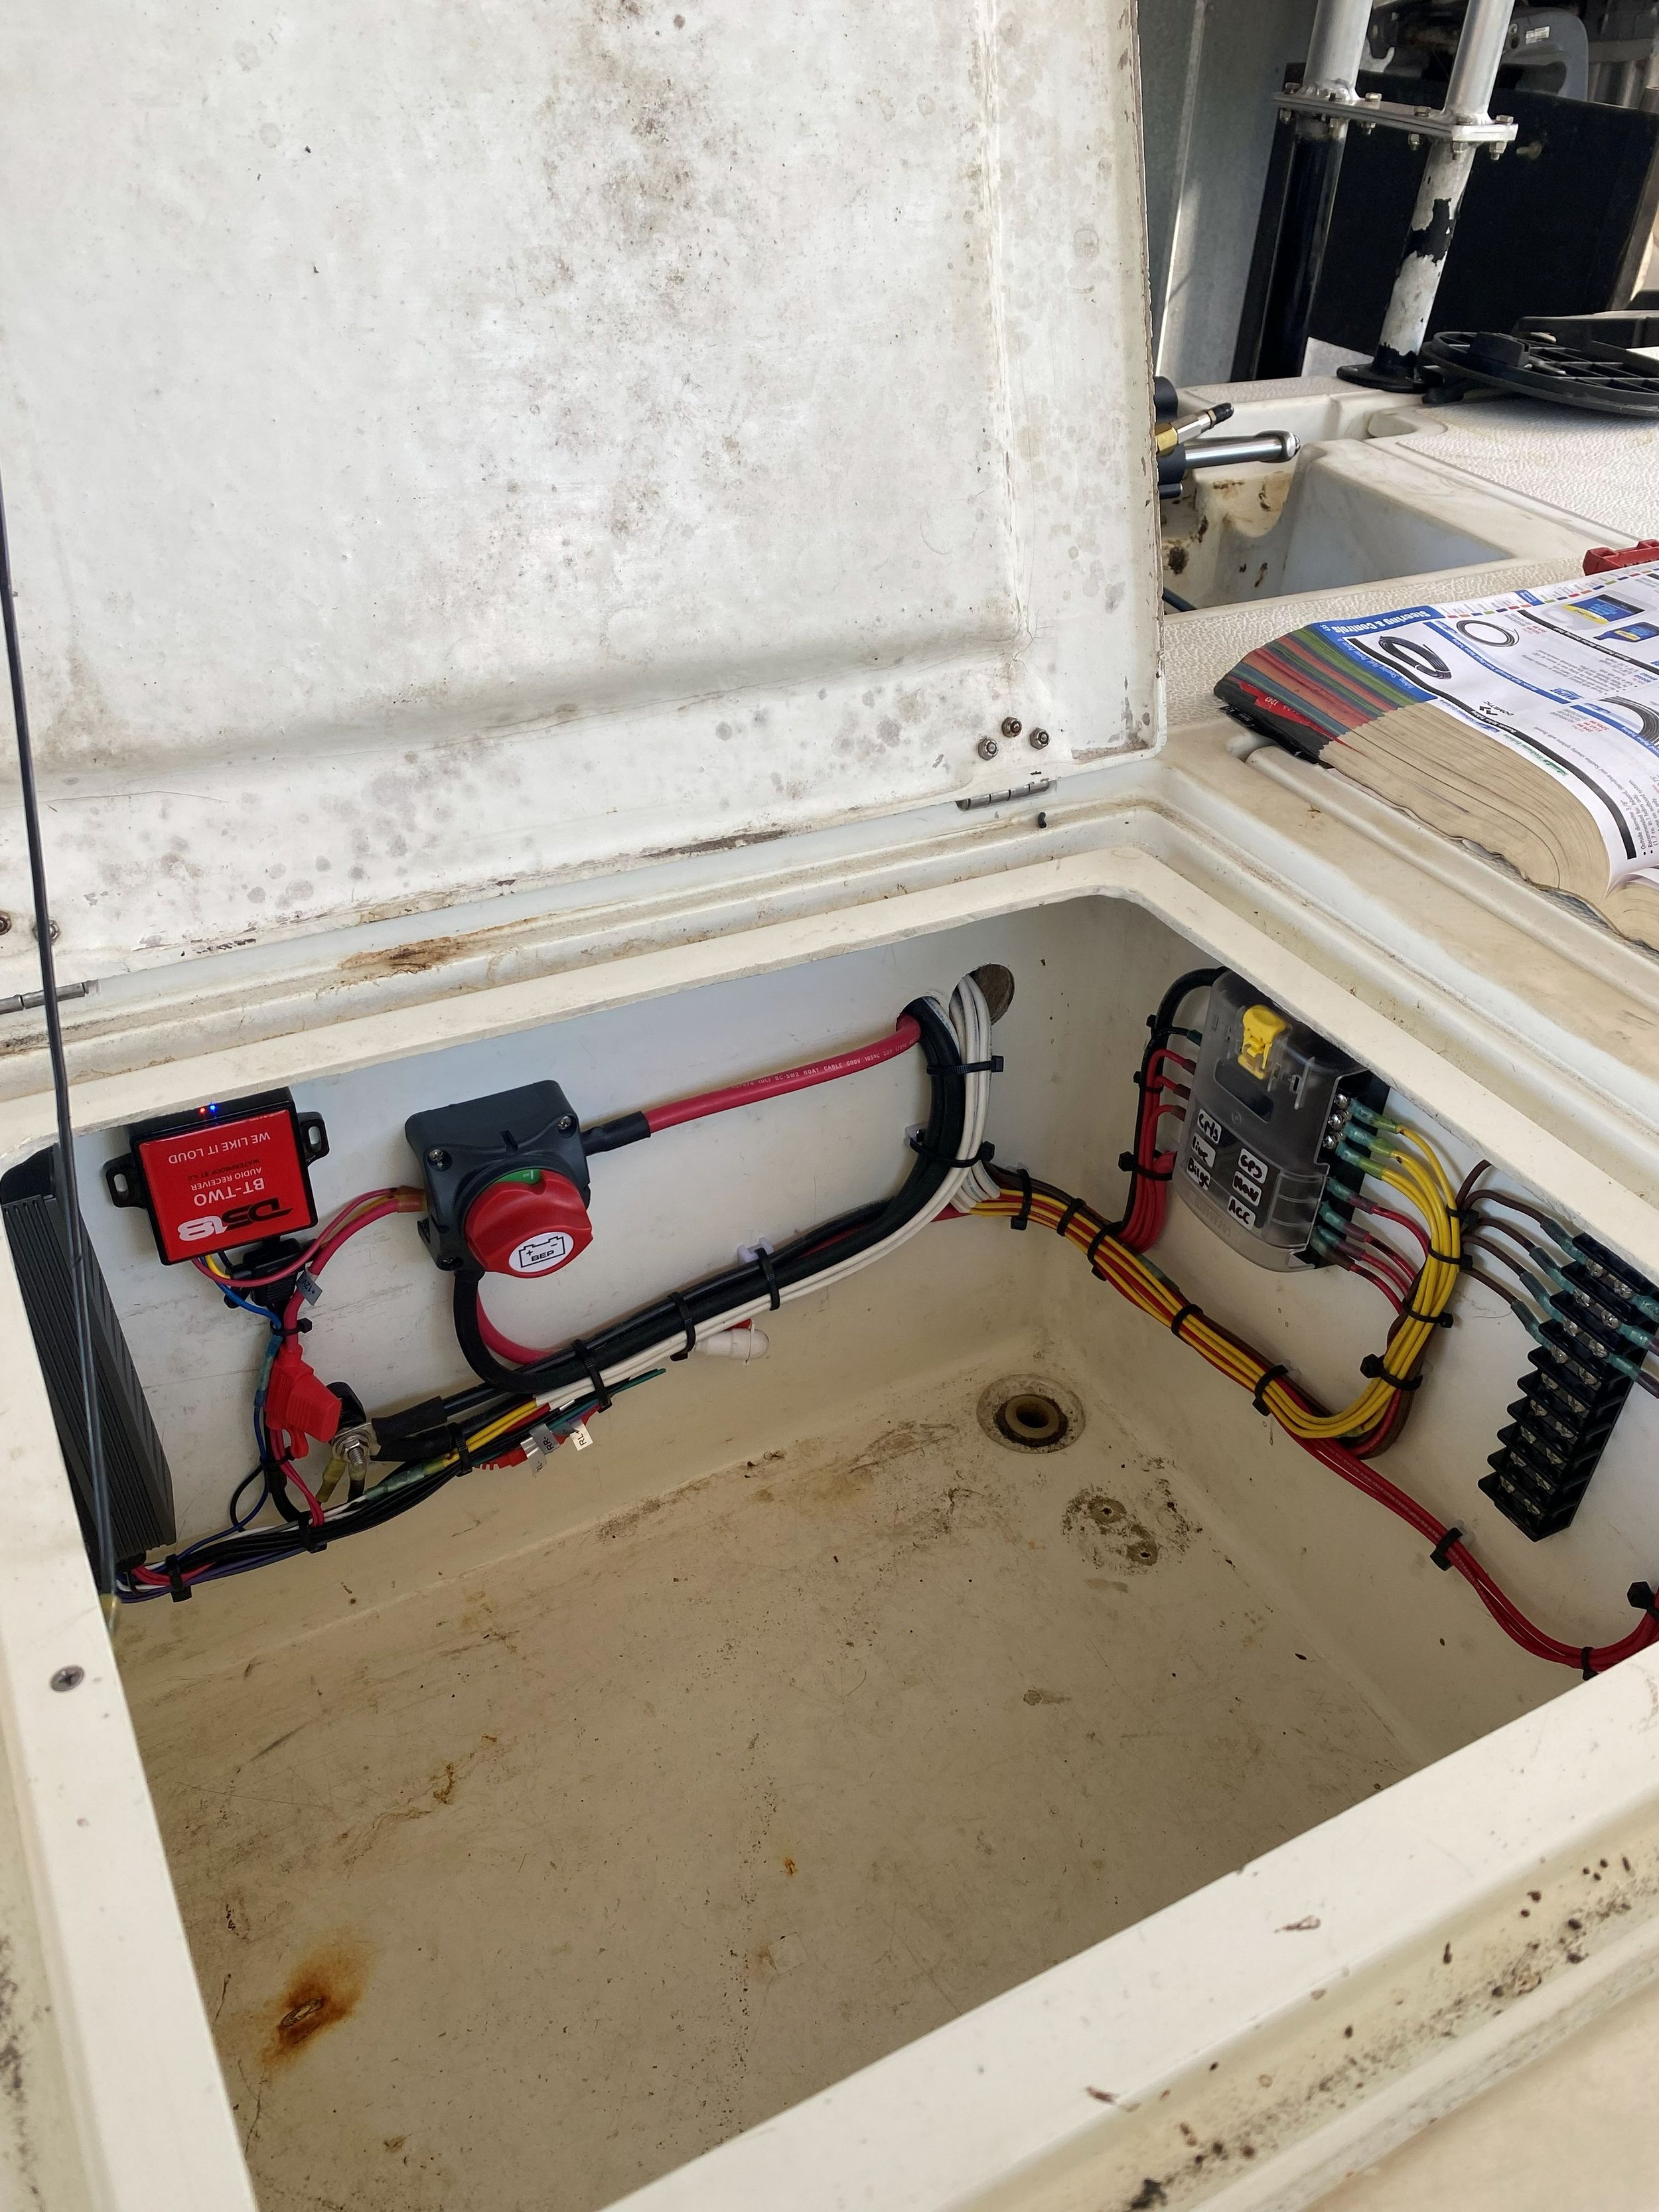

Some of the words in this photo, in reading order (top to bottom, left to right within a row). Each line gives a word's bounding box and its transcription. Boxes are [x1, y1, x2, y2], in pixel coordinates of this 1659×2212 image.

[1384, 611, 1431, 625] Steering
[1331, 621, 1377, 634] Controls
[1483, 700, 1514, 715] DOMETIC
[1630, 812, 1640, 831] diameter
[1638, 814, 1653, 848] Recommended
[1638, 832, 1646, 849] Outside
[824, 1063, 843, 1071] CABLE
[221, 1136, 248, 1150] LIKE
[250, 1132, 271, 1145] WE
[169, 1147, 204, 1164] LOUD
[206, 1143, 220, 1155] IT
[211, 1158, 259, 1175] WATERPROOF
[234, 1167, 262, 1180] AUDIO
[190, 1172, 233, 1191] RECEIVER
[193, 1177, 265, 1207] BT-TWO
[177, 1197, 295, 1242] DS18
[530, 1250, 554, 1262] BEP
[301, 1279, 315, 1295] +12V
